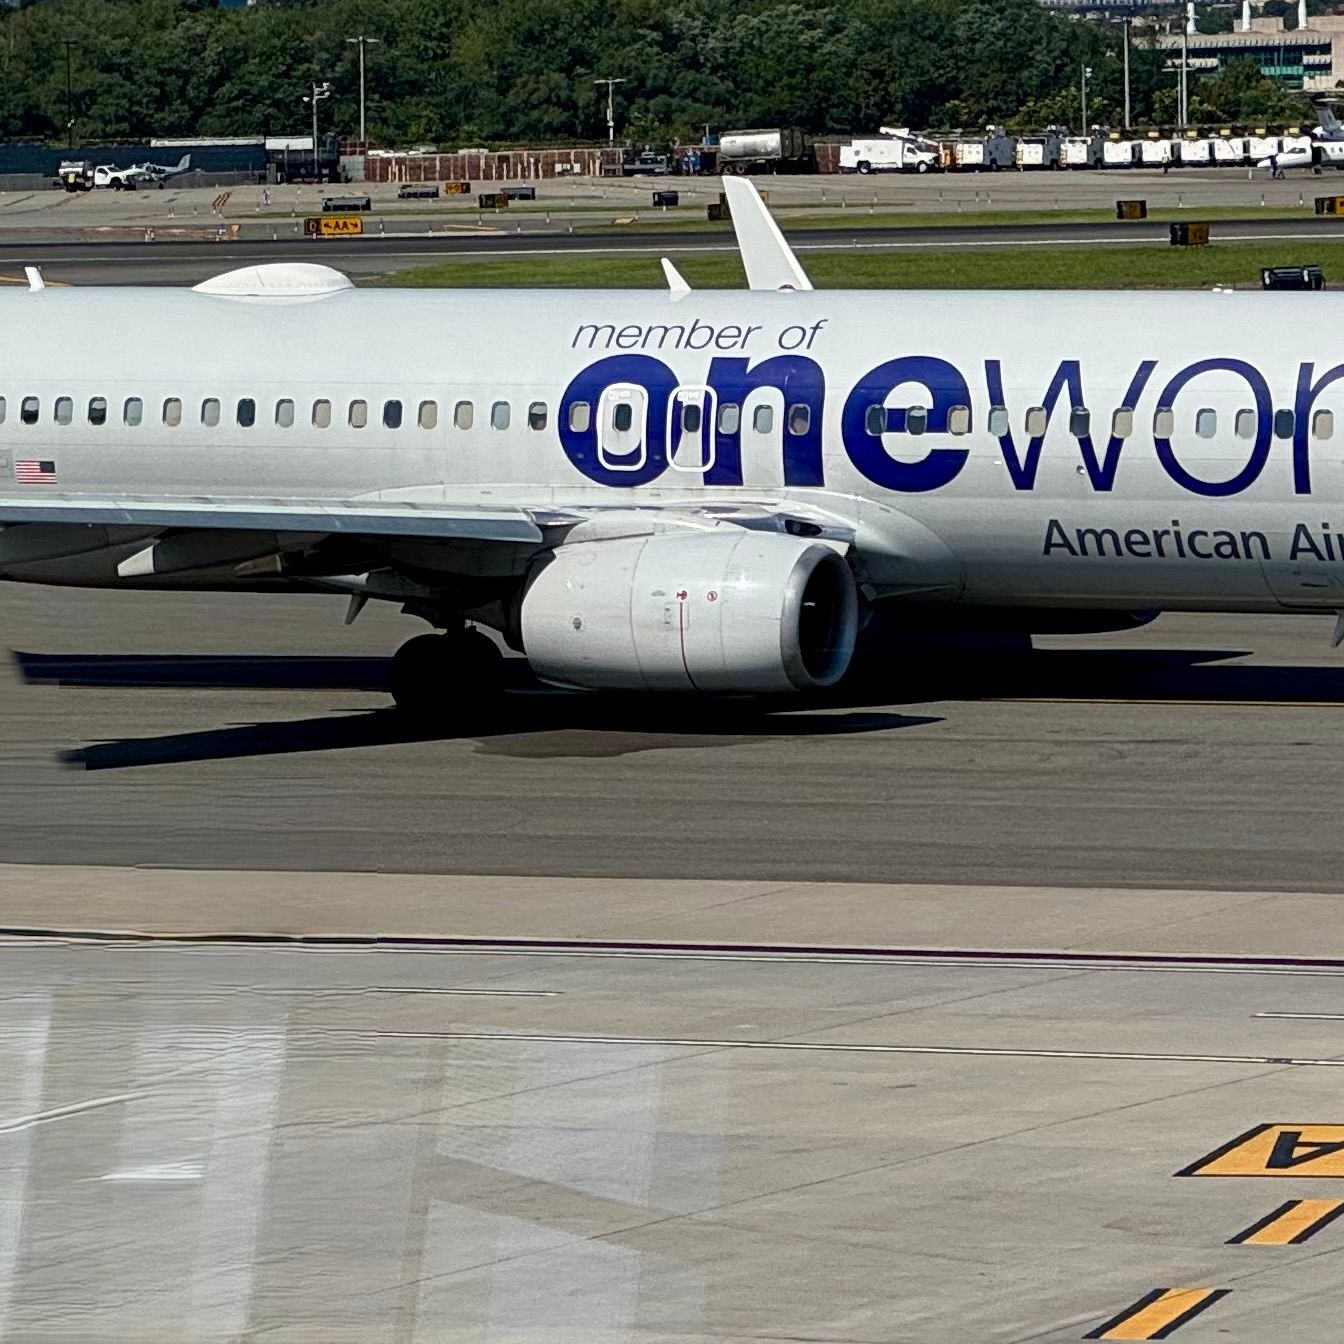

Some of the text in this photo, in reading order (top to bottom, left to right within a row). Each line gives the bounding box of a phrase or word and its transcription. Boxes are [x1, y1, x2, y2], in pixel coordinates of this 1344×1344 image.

[334, 220, 349, 230] AA
[571, 319, 828, 350] member of
[1043, 519, 1271, 560] American
